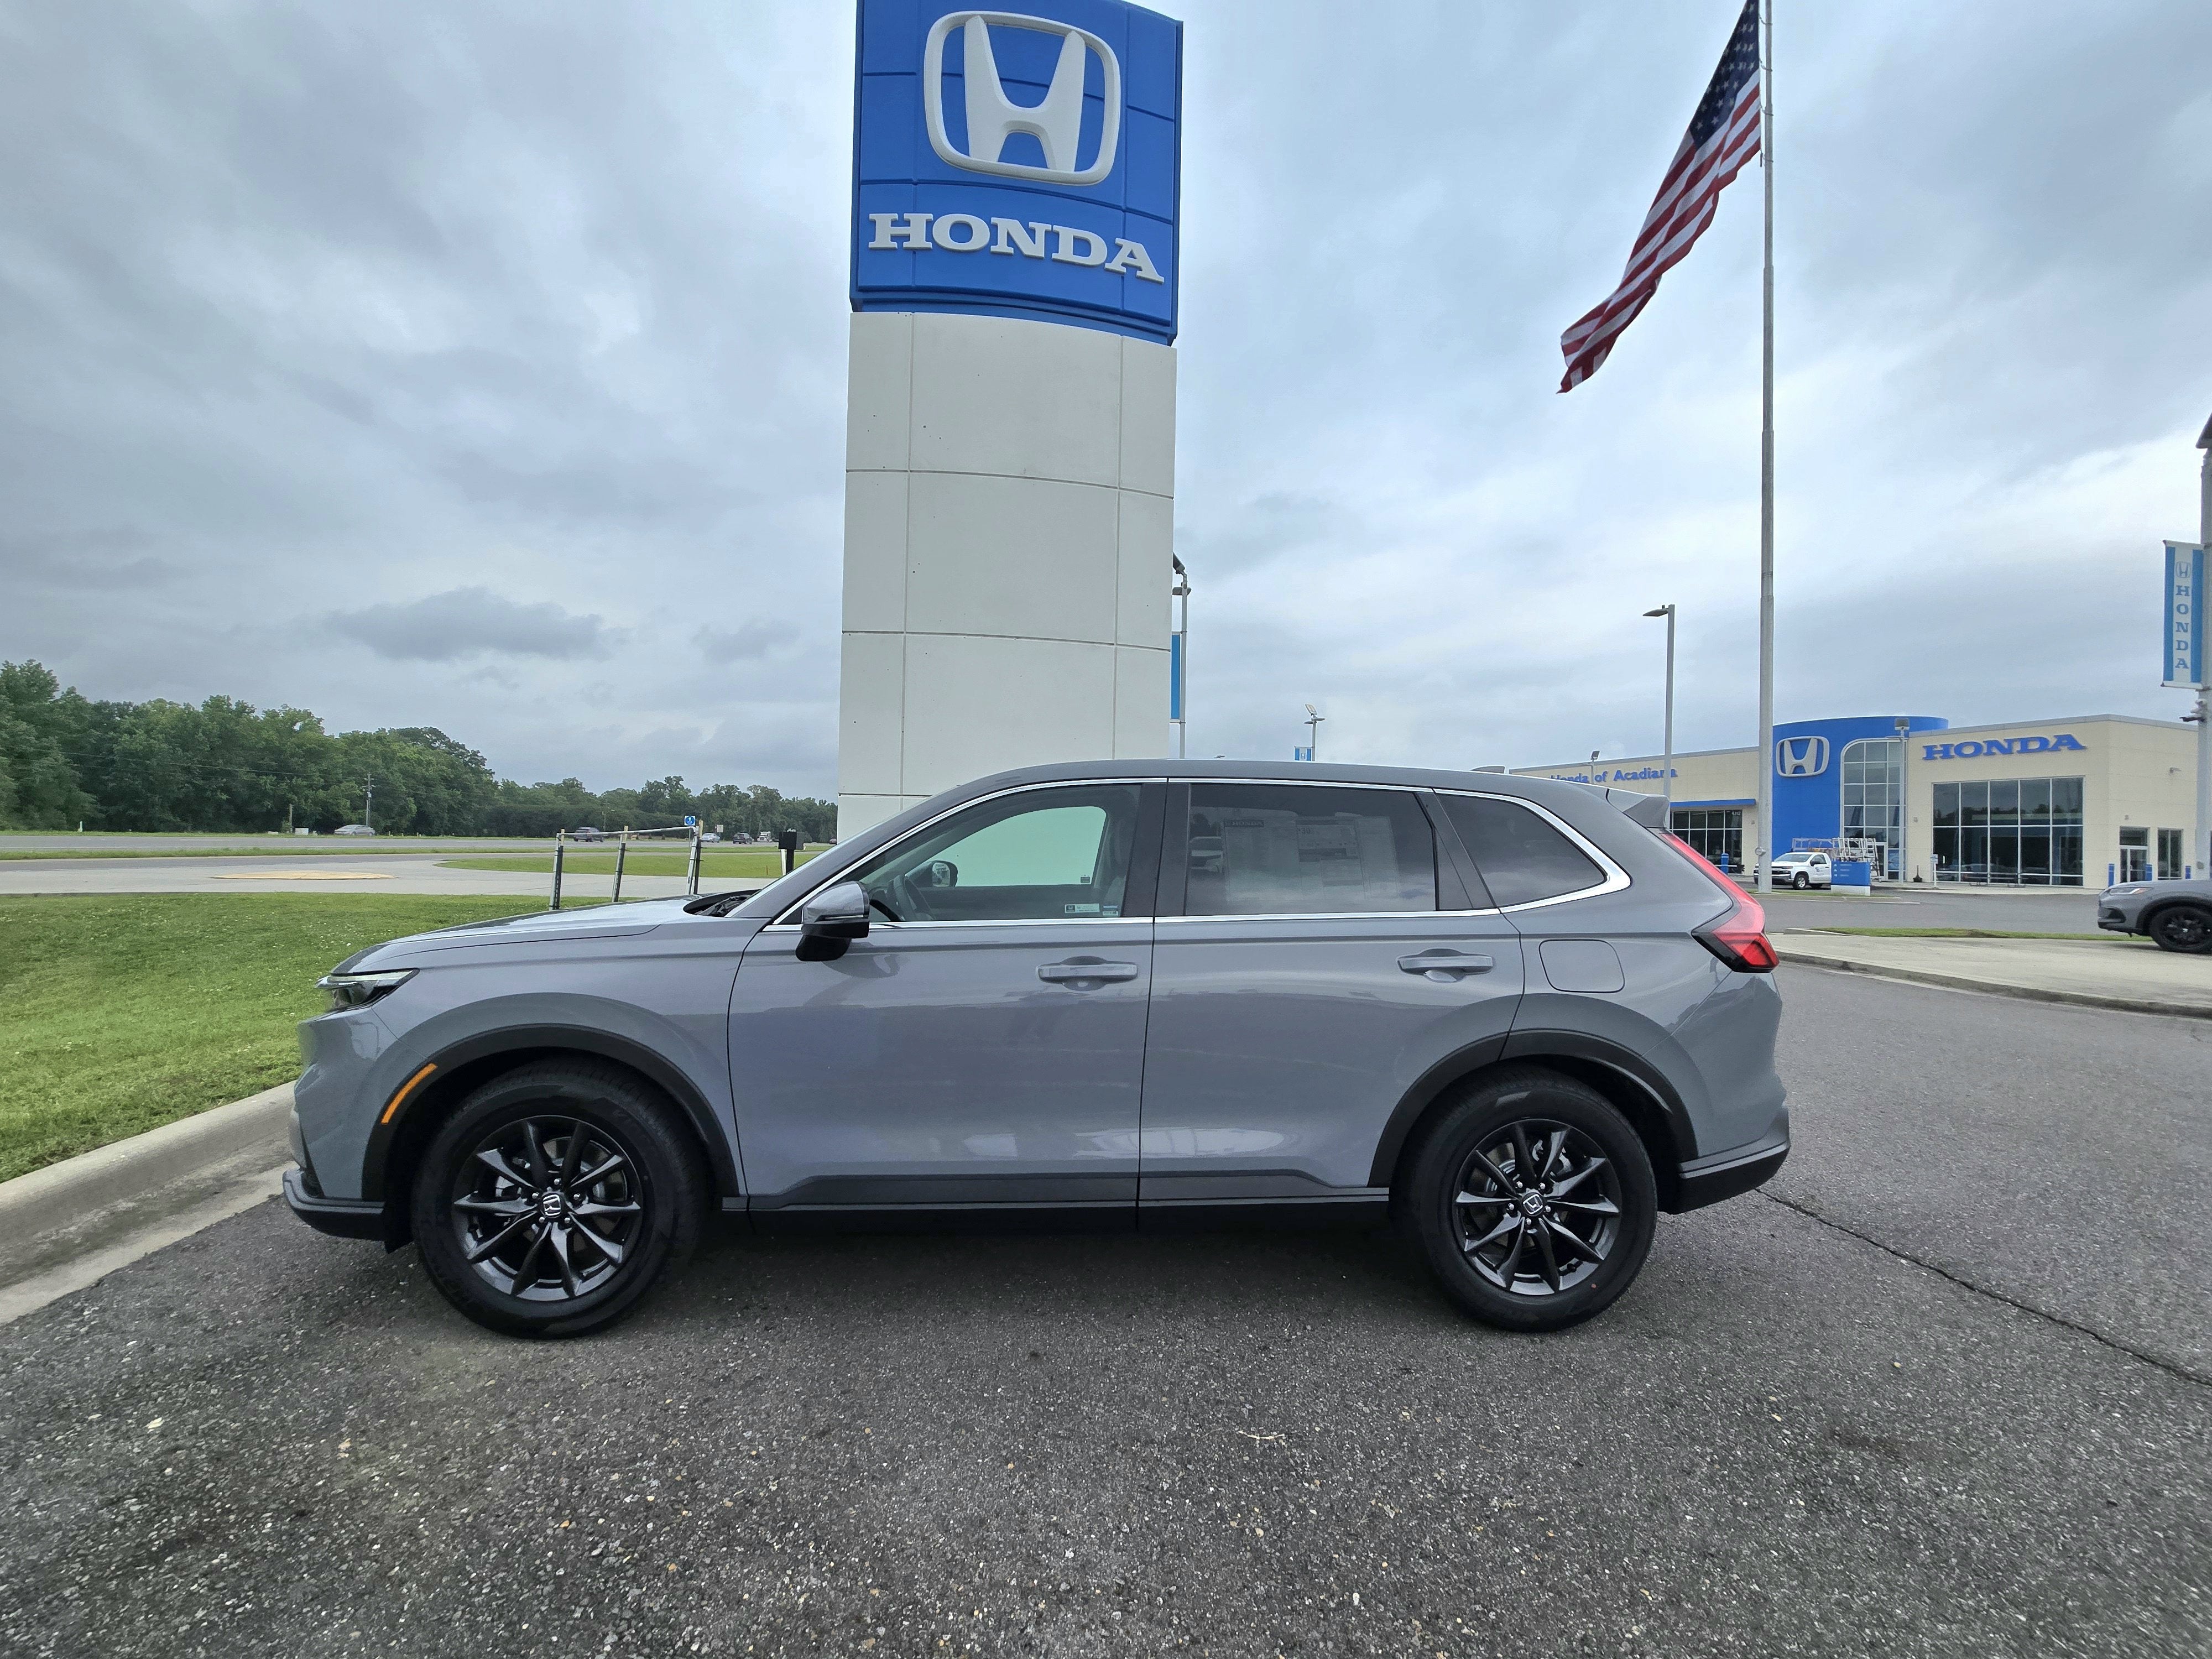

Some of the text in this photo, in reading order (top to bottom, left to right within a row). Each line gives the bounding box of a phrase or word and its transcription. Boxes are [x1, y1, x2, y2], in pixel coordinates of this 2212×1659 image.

[868, 213, 1165, 284] HONDA
[2175, 585, 2190, 669] HONDA
[1922, 734, 2088, 761] HONDA
[1594, 771, 1608, 782] of
